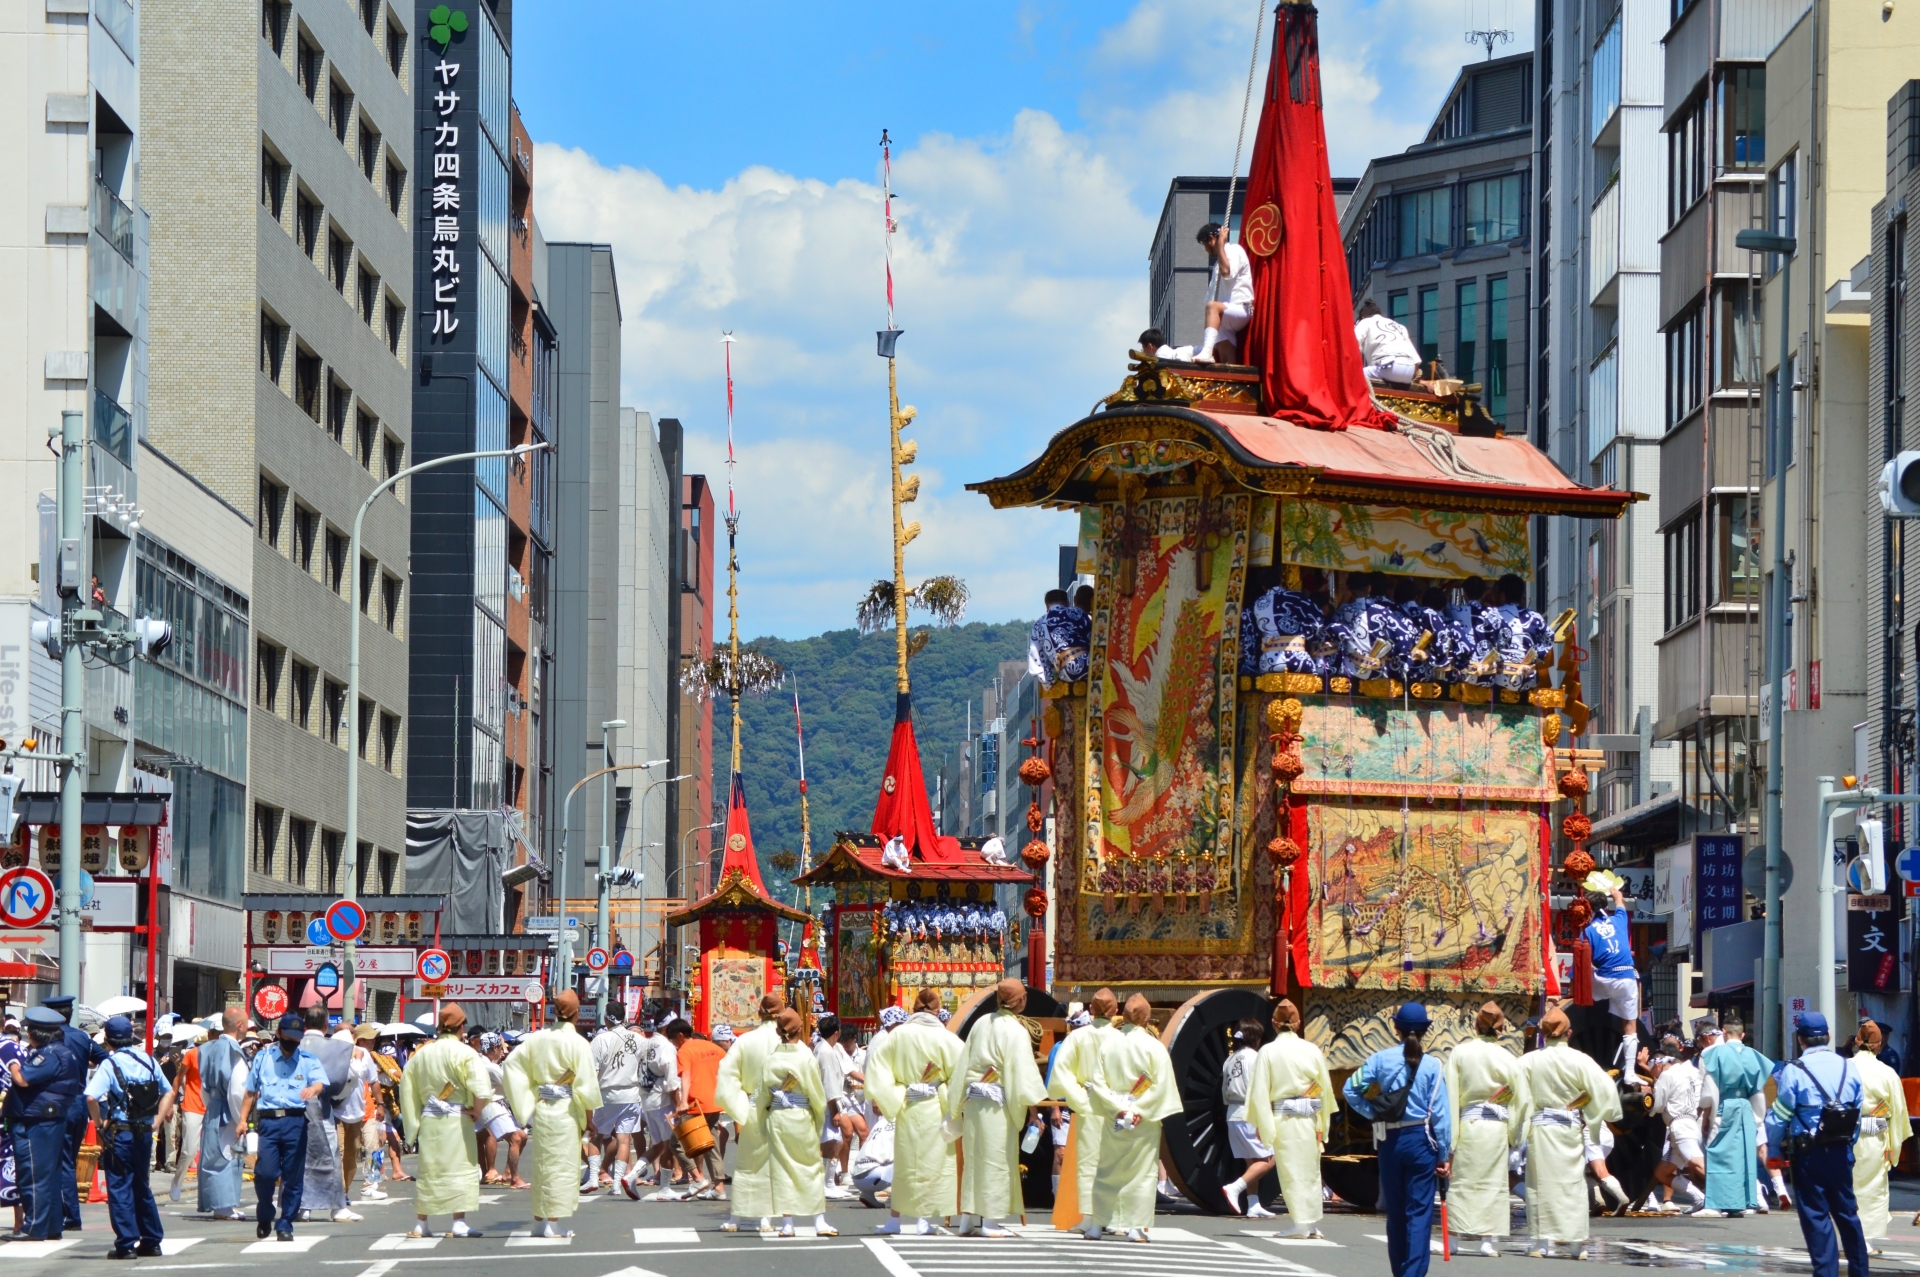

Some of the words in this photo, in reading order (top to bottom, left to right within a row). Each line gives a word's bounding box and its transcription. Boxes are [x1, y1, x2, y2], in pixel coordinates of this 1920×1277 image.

[432, 59, 460, 334] ヤサカ四条烏丸ビル
[0, 645, 20, 768] Life-sty
[1702, 842, 1716, 931] 池坊文化
[1721, 842, 1736, 919] 池坊短期
[1850, 898, 1890, 908] 自転車通行可
[305, 958, 378, 970] ラーン力屋
[444, 984, 521, 995] ホリーズカフェ
